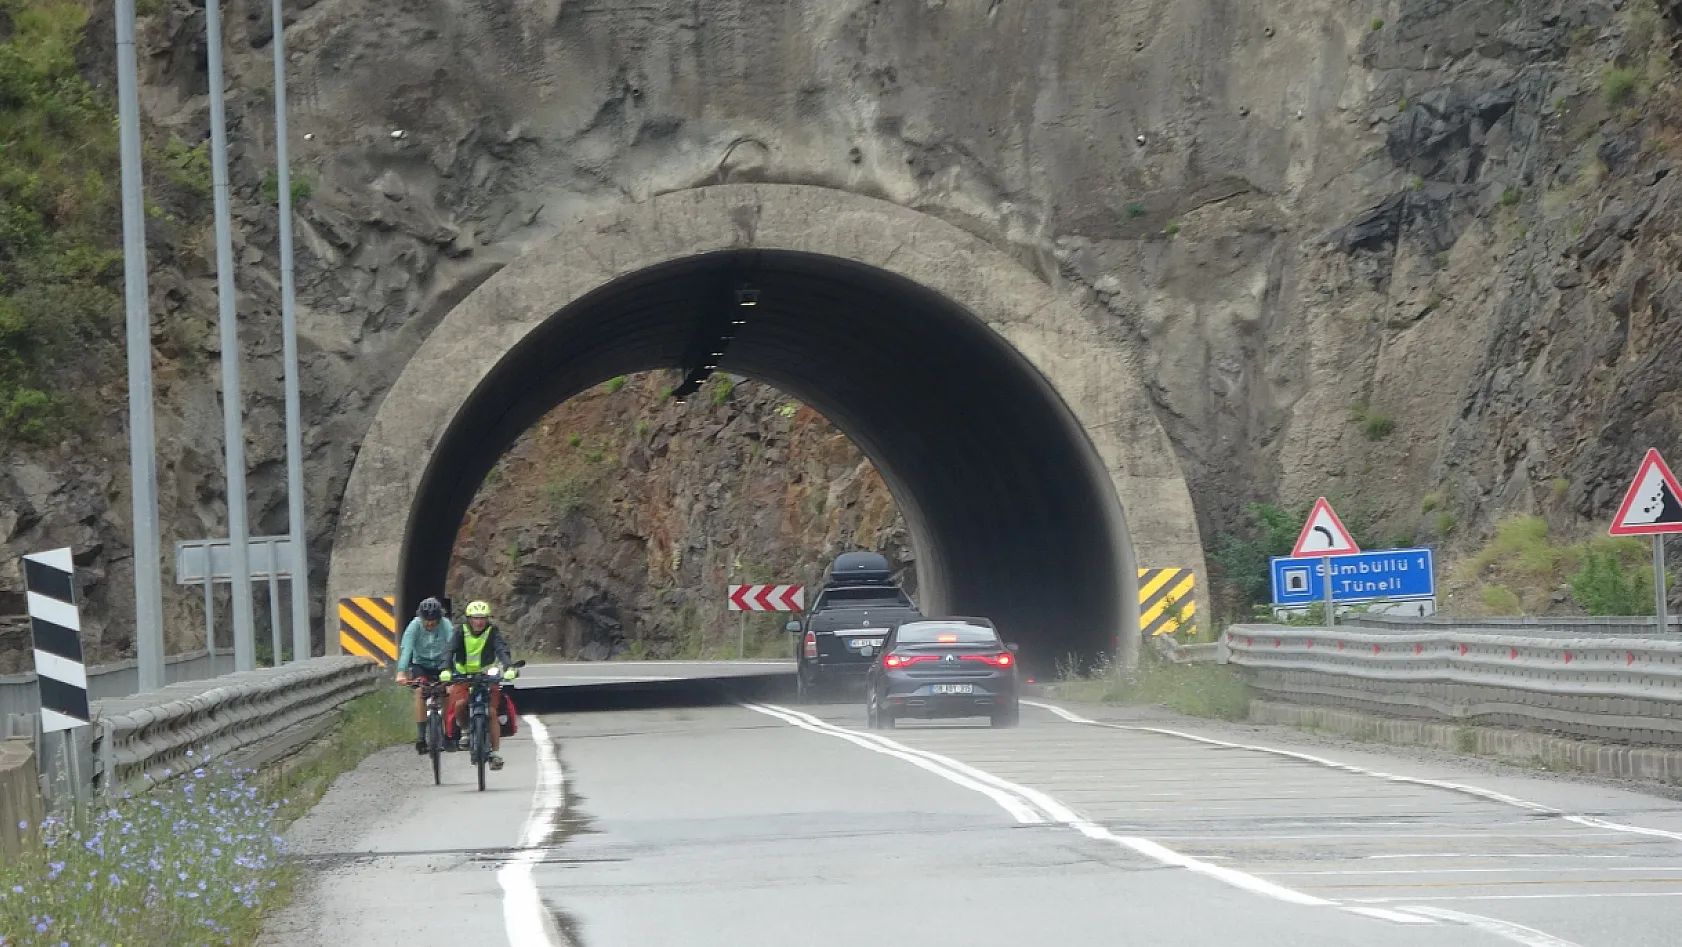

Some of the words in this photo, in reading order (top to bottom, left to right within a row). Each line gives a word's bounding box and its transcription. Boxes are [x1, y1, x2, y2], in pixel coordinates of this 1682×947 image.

[1315, 558, 1408, 577] Sümbüllü
[1417, 557, 1425, 570] 1
[1341, 577, 1401, 593] Tüneli
